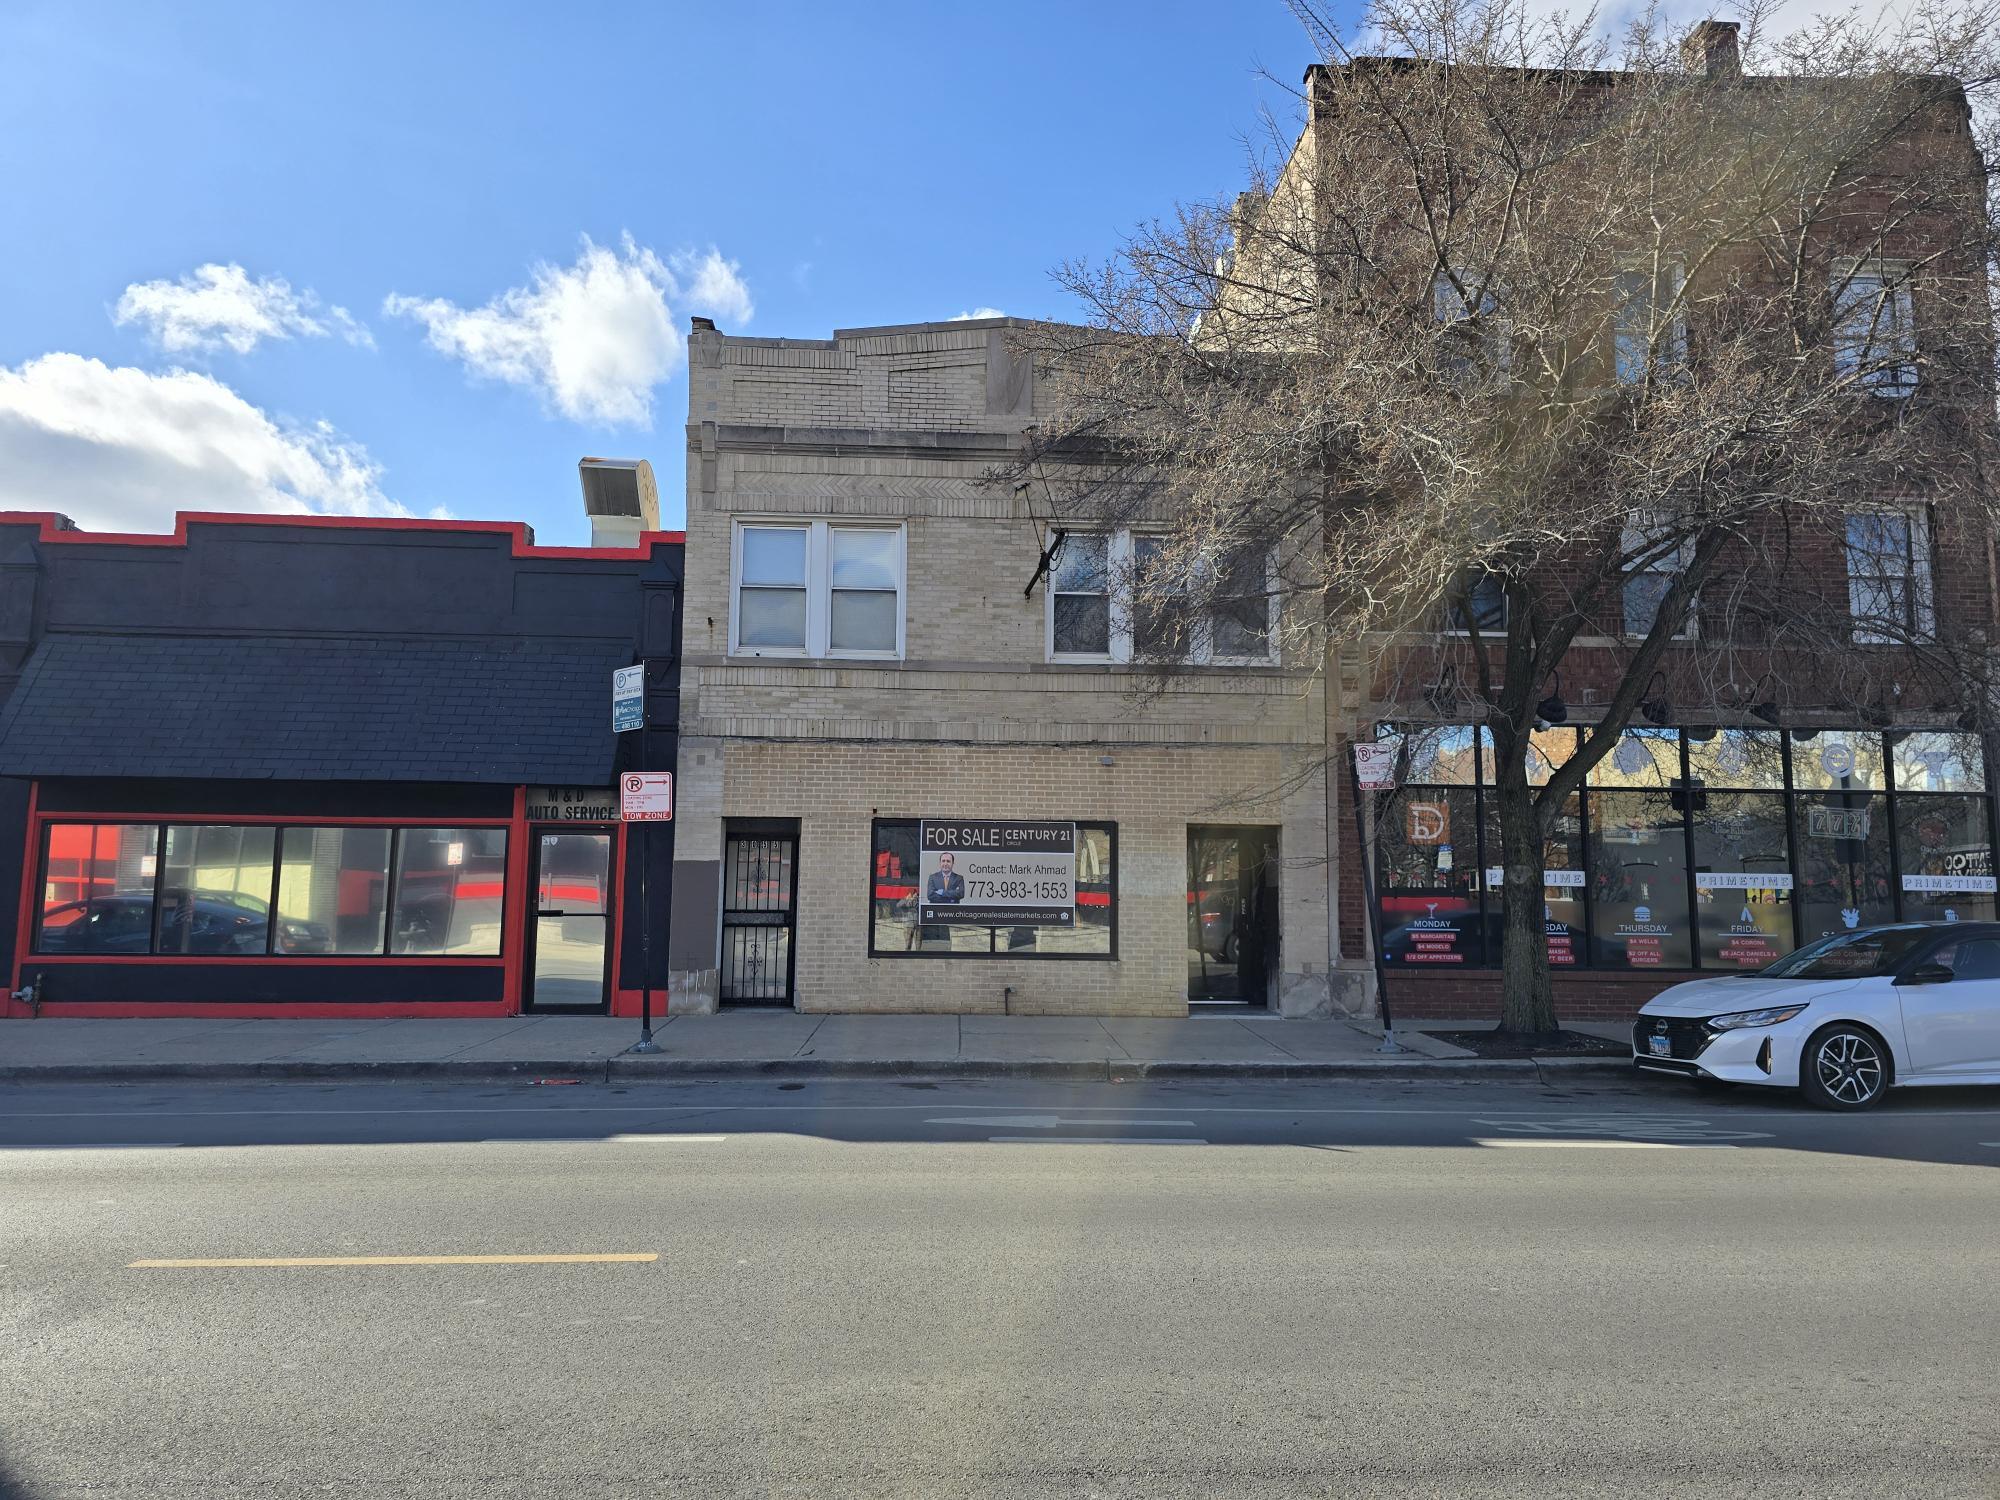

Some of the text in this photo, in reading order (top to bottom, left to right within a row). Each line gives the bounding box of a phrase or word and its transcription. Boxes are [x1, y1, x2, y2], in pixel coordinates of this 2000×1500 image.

[547, 789, 585, 803] M & D
[527, 805, 615, 821] AUTO SERVICE
[626, 812, 642, 820] TOW
[926, 828, 1000, 847] FOR SALE
[1005, 829, 1071, 841] CENTURY 21
[968, 863, 1067, 876] Contact: Mark Ahmad
[1698, 876, 1790, 887] PRIMETIME
[1903, 878, 1993, 890] PRIMETIME
[968, 881, 1068, 900] 773-983-1553
[937, 911, 1057, 920] www.chicagorealestatemarkets.com
[1414, 920, 1451, 928] MONDAY
[1618, 924, 1667, 932] THURSDAY
[1730, 925, 1764, 933] FRIDAY
